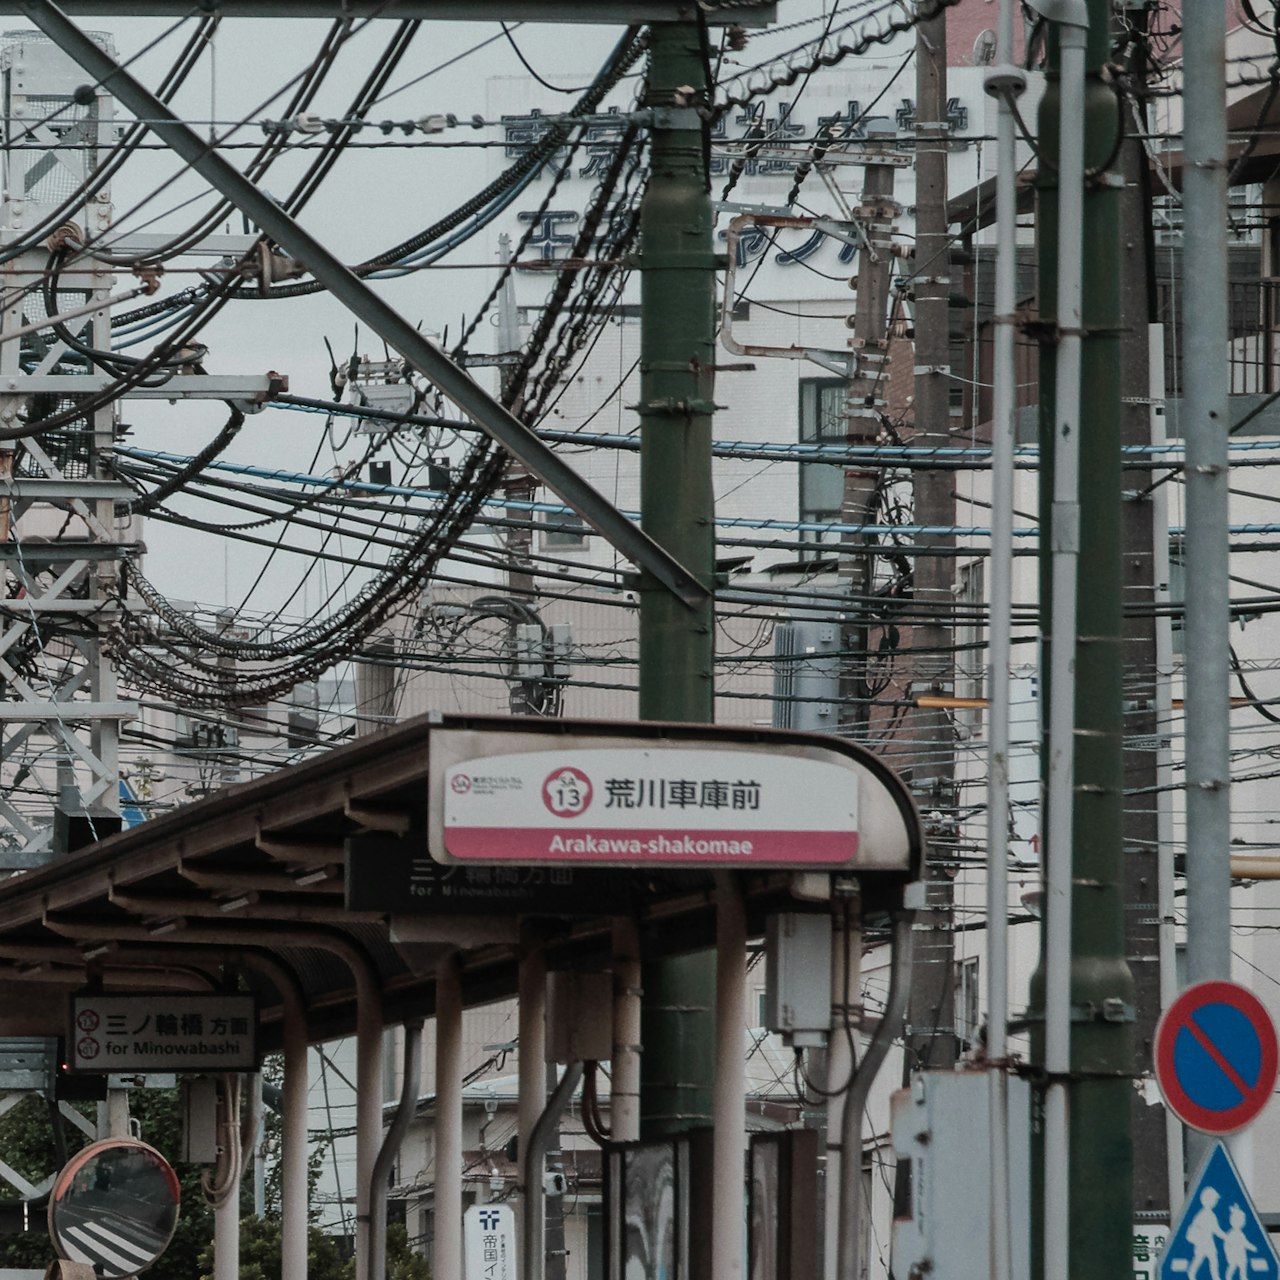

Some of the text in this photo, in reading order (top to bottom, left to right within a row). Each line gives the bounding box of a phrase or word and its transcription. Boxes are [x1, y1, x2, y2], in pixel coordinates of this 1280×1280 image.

[556, 789, 581, 807] 13
[605, 779, 761, 810] 荒川車庫前
[549, 834, 754, 855] Arakawa-shakomae
[106, 1013, 249, 1036] 三ノ輪橋 方面
[106, 1041, 241, 1055] for Minowabashi
